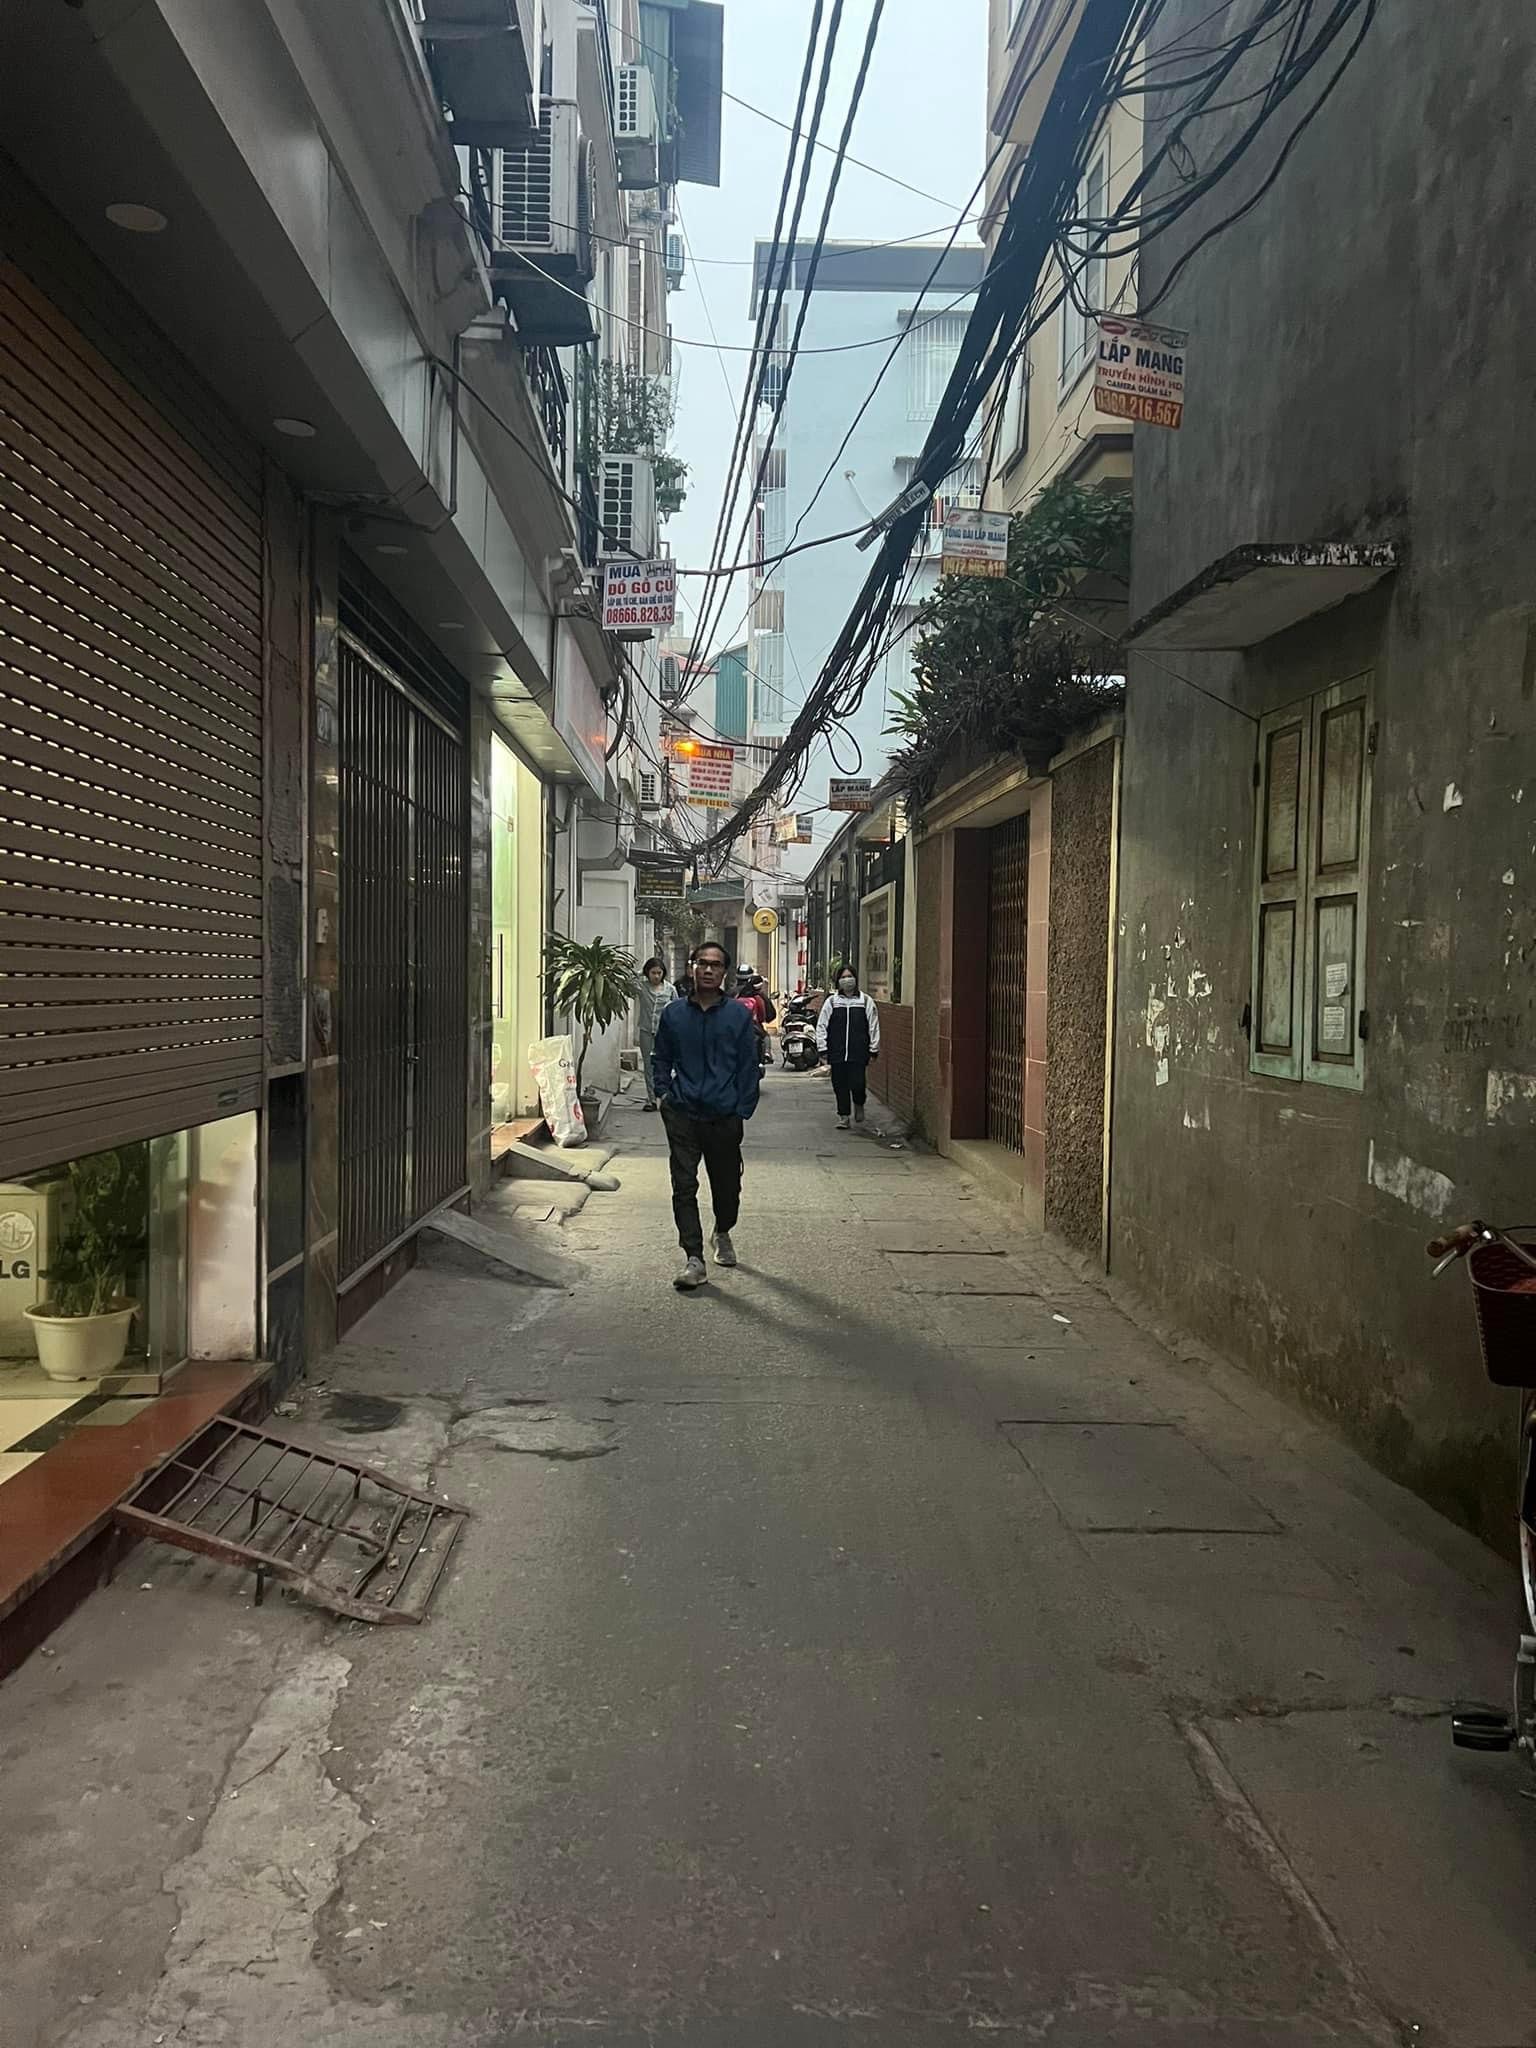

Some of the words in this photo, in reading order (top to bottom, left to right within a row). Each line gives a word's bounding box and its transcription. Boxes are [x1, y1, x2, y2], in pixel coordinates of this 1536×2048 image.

[1099, 336, 1131, 363] LẮP
[1136, 347, 1184, 375] MẠNG
[1097, 367, 1136, 381] TRUYỀN
[1139, 374, 1166, 387] HÌNH
[1168, 381, 1183, 391] HD
[1106, 380, 1136, 391] CAMERA
[609, 565, 641, 579] MUA
[607, 579, 626, 596] ĐỒ
[631, 577, 651, 594] GỖ
[655, 577, 673, 593] CŨ
[606, 605, 673, 624] 08666.828.33
[0, 1260, 31, 1279] LG
